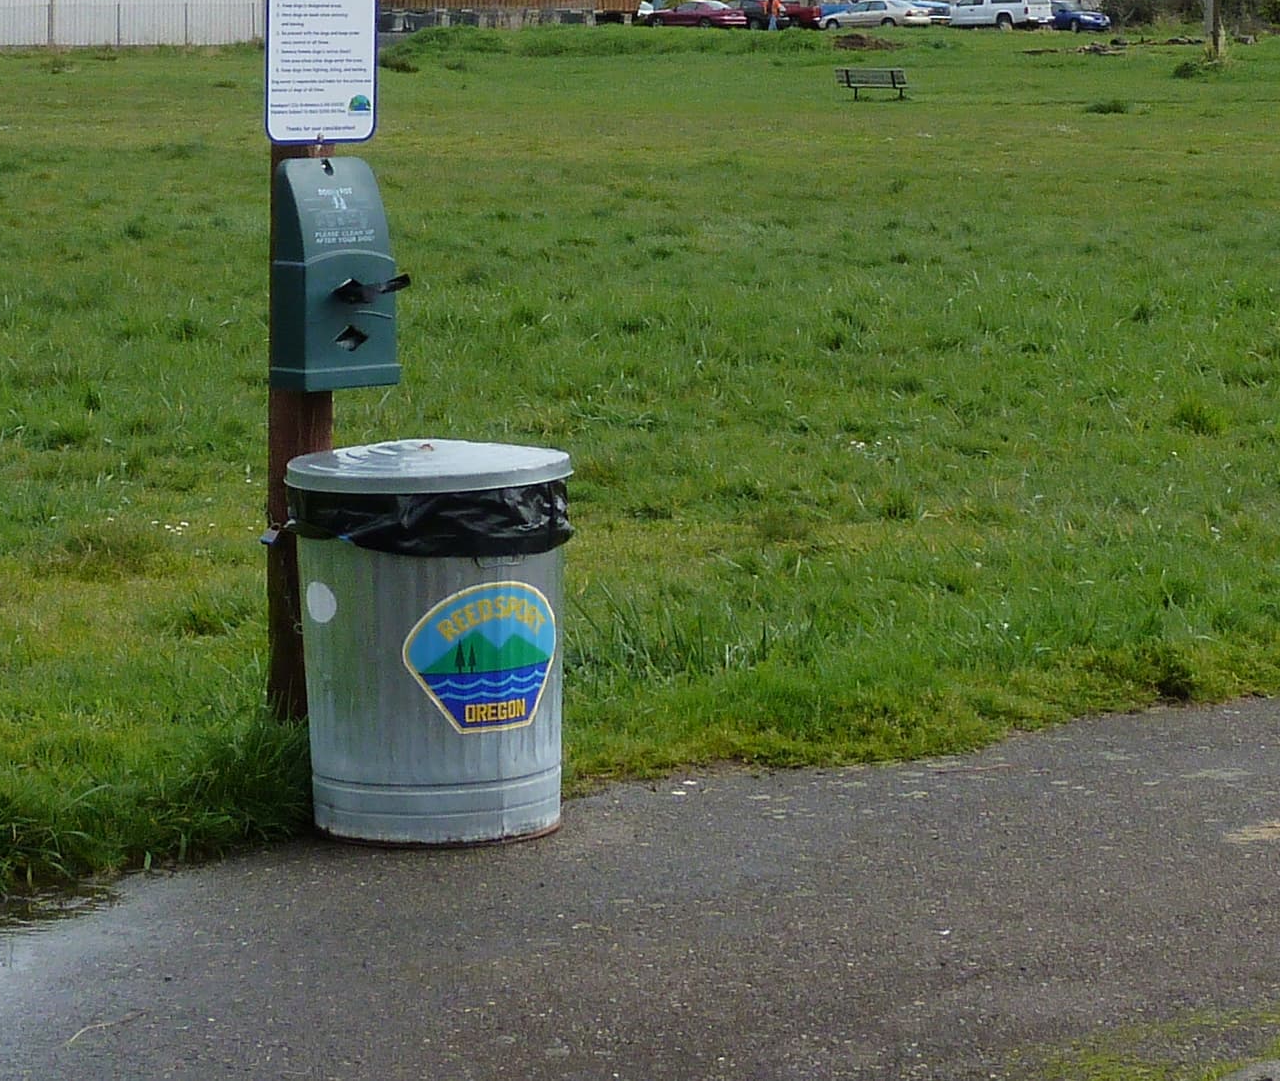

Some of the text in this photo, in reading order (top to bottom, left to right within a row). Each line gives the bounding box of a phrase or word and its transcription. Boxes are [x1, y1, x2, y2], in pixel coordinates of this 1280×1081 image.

[314, 230, 339, 238] PLEASE
[338, 236, 356, 244] YOUR
[436, 595, 547, 643] REEDSPORT
[464, 698, 526, 723] OREGON
